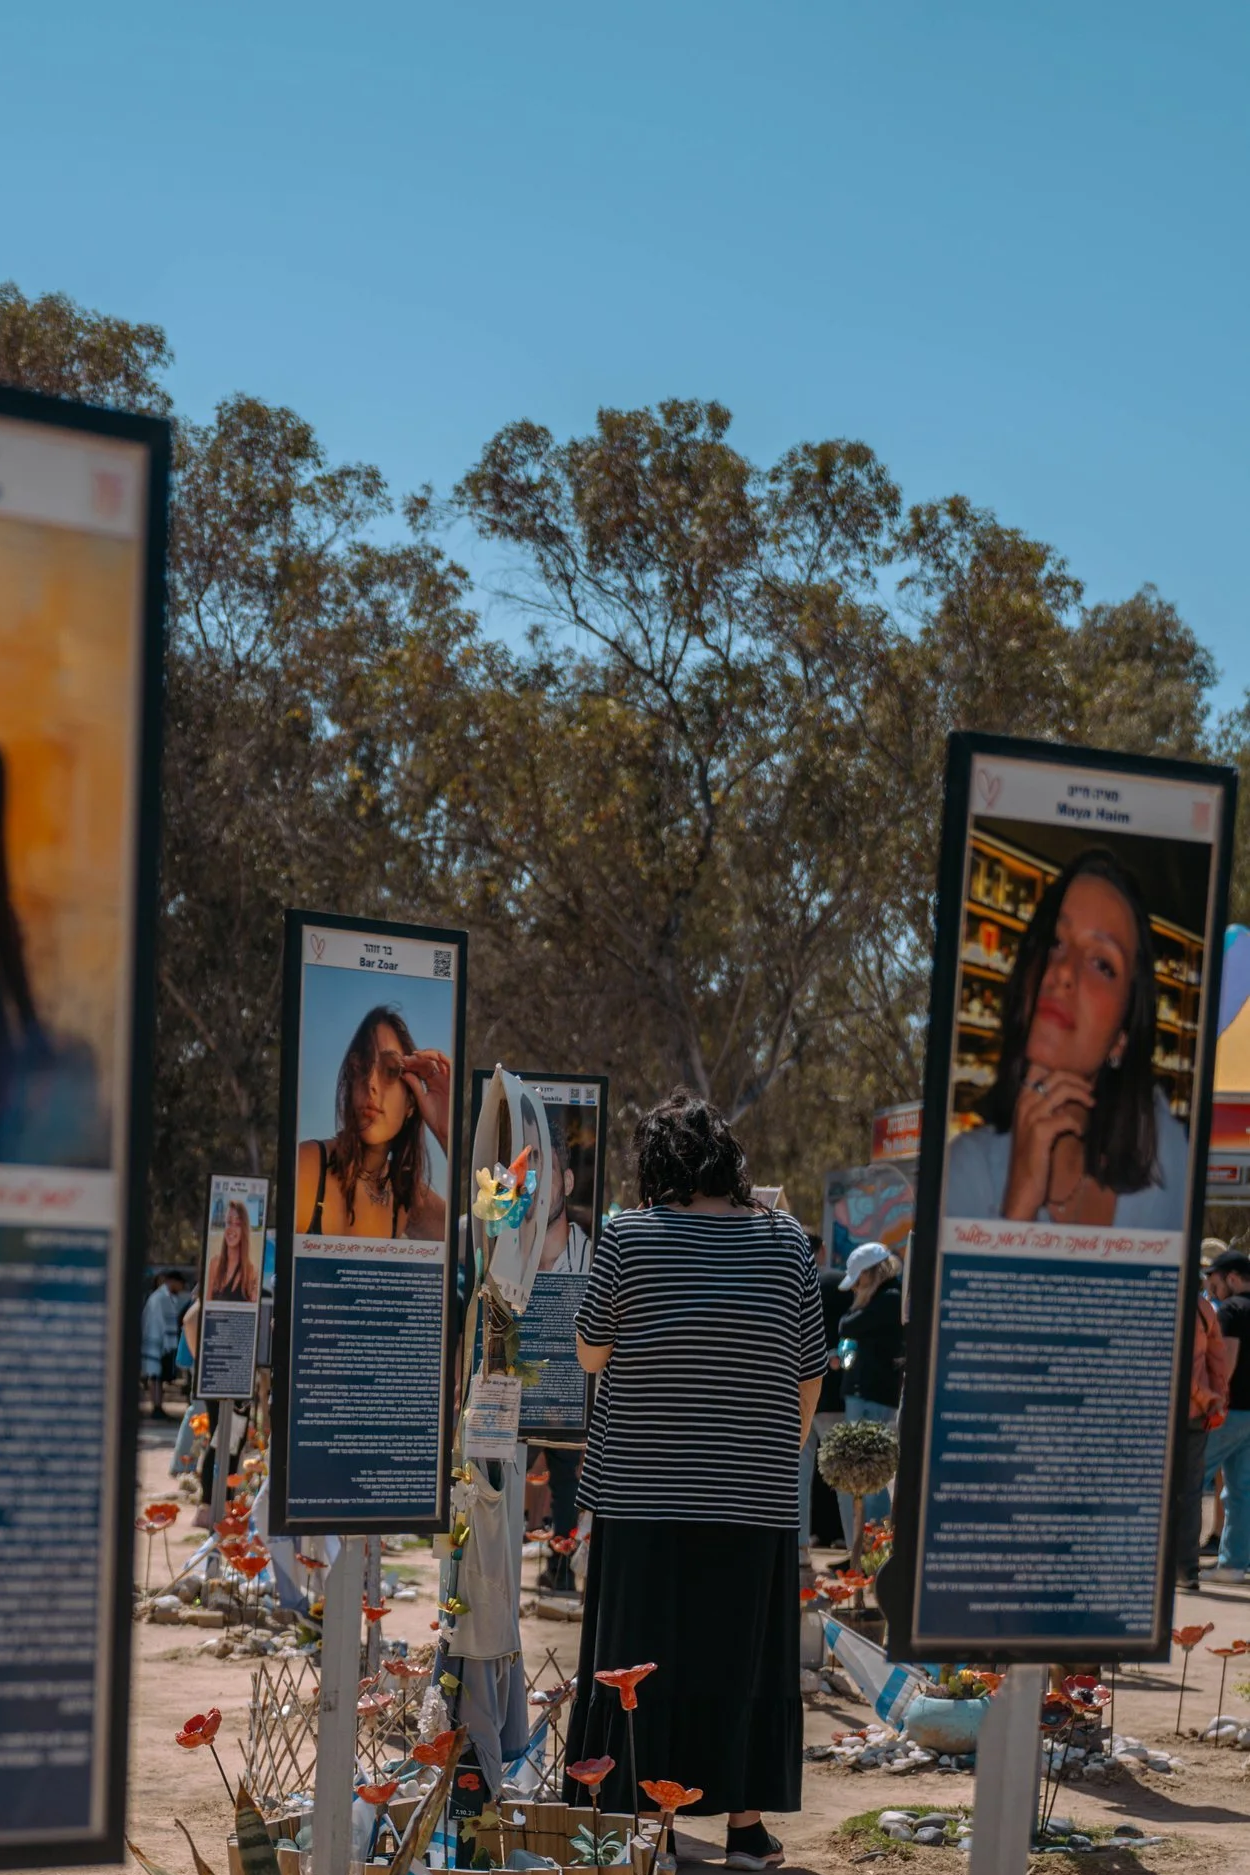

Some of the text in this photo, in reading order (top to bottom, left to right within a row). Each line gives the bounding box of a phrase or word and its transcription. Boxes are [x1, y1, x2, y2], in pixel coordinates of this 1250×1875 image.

[1057, 802, 1130, 824] Maya Haim
[364, 943, 393, 956] בר זוהר
[359, 957, 399, 971] Bar Zoar
